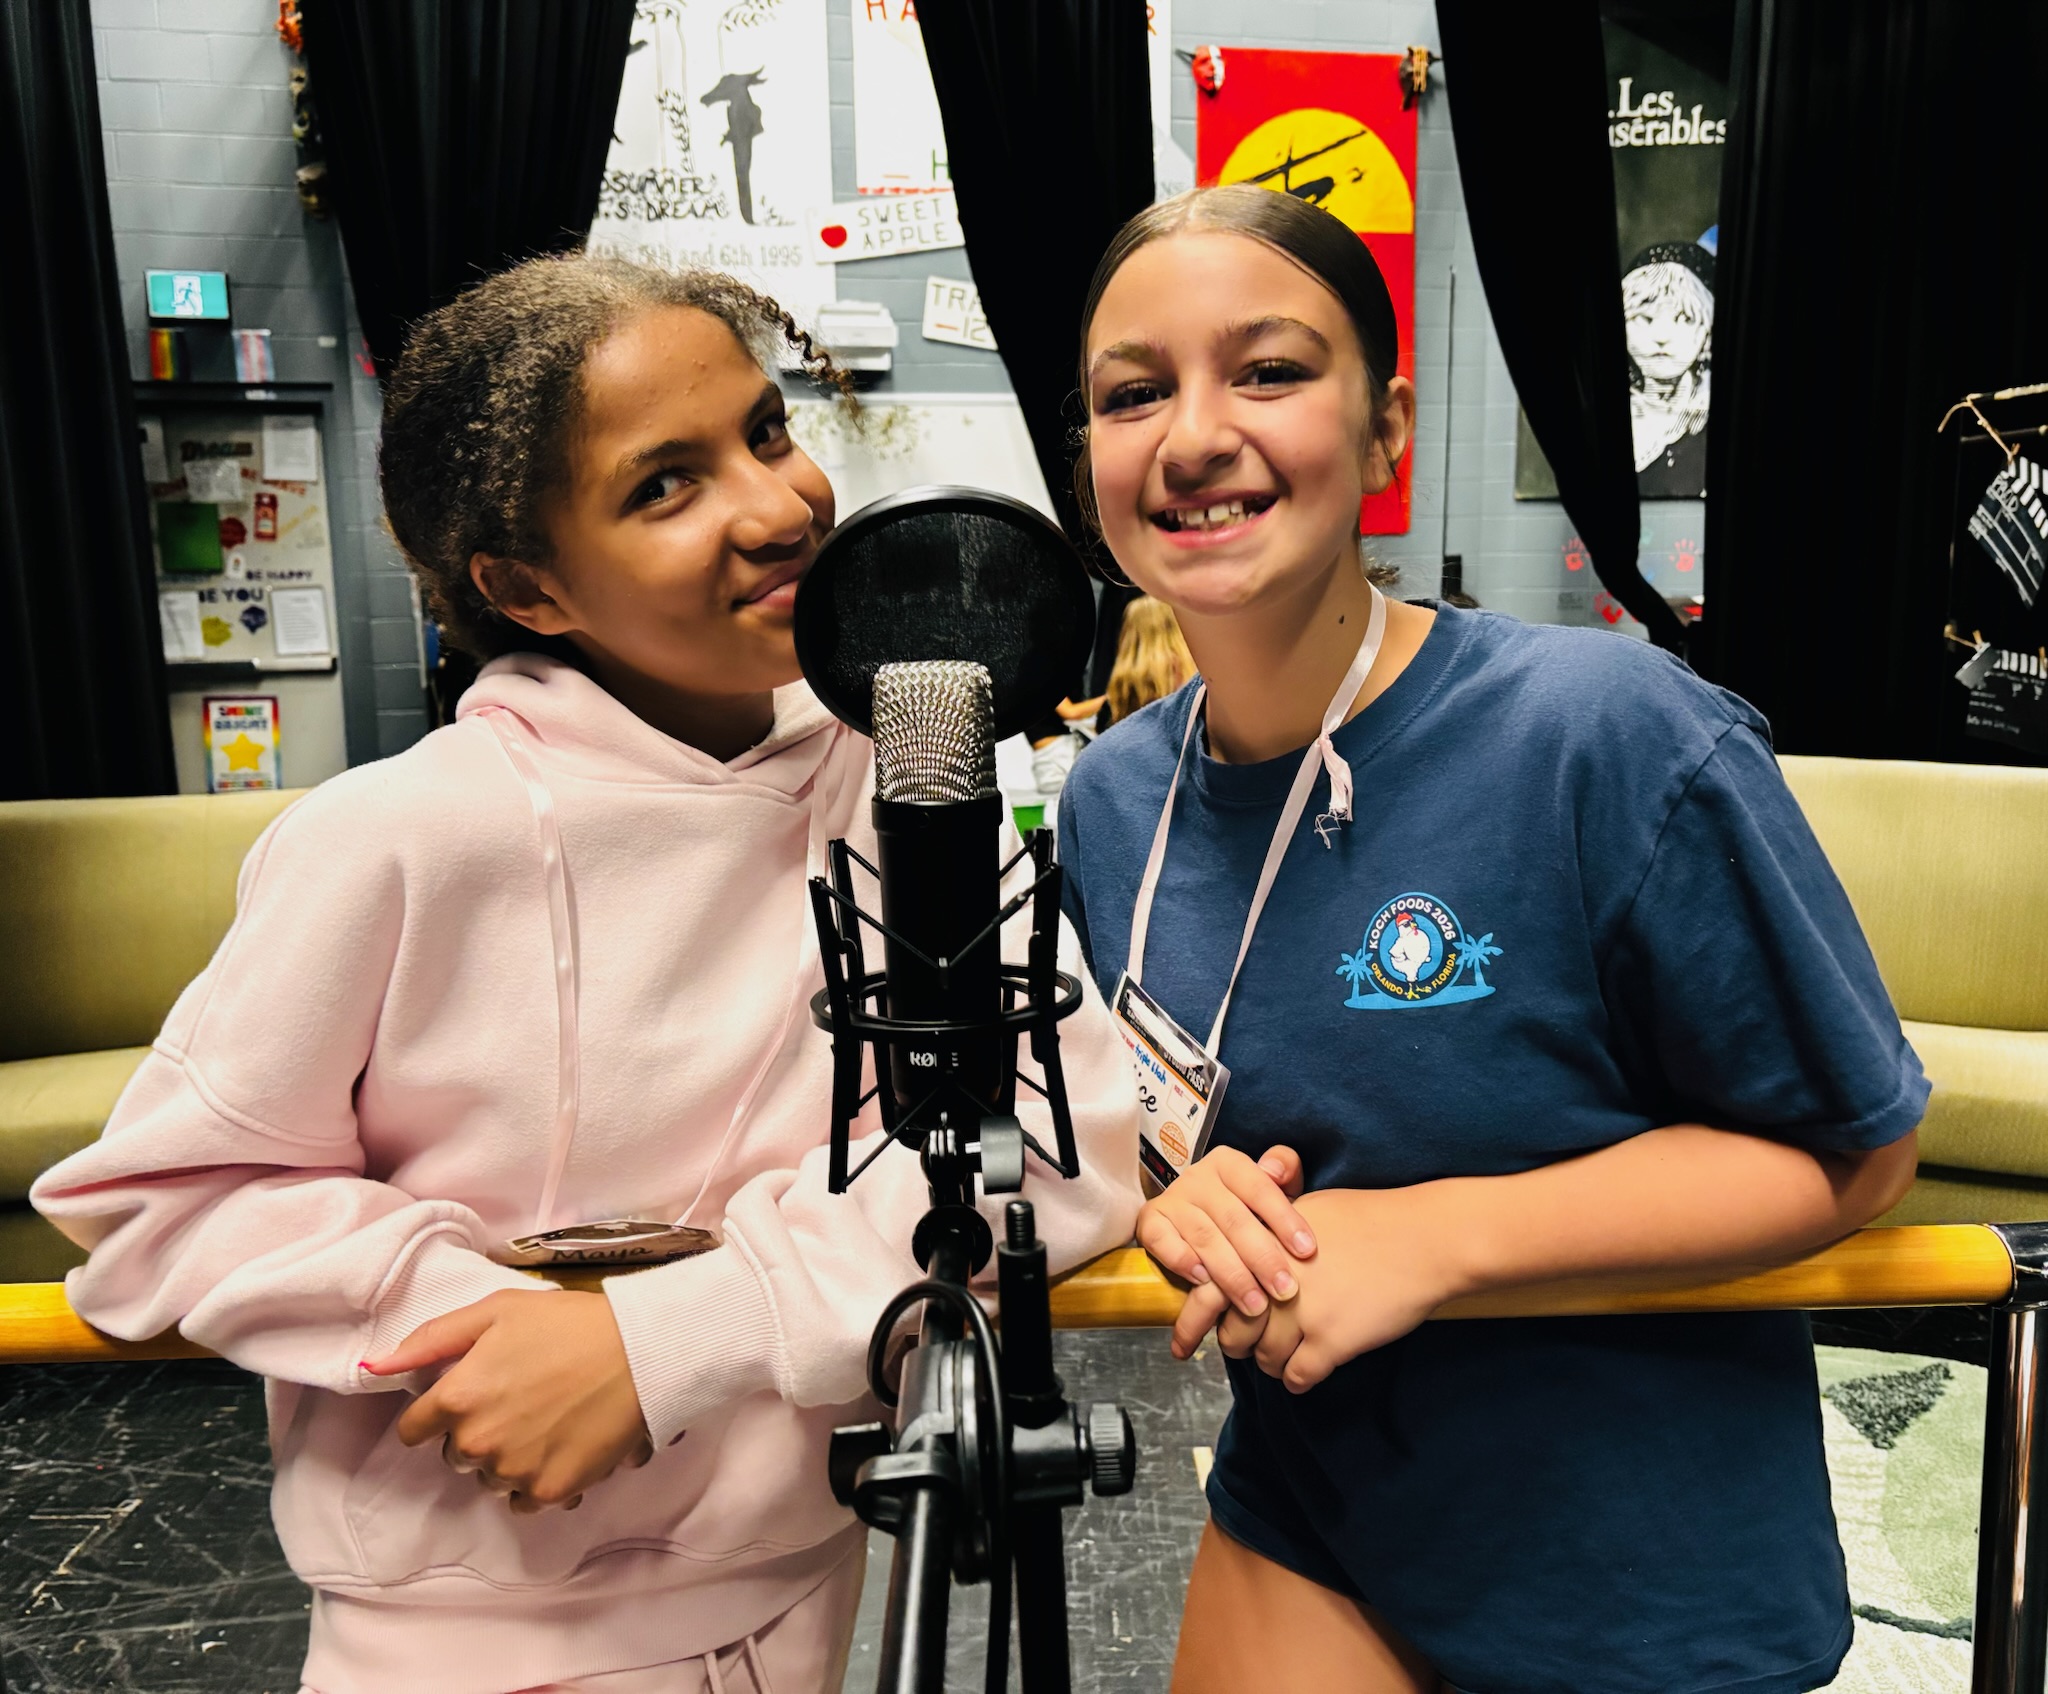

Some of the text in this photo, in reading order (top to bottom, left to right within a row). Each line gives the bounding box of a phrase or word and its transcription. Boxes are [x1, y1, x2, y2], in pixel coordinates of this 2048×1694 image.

[1616, 76, 1675, 118] Les
[646, 199, 727, 221] DREAM
[857, 197, 942, 228] SWEET
[863, 222, 949, 251] APPLE
[760, 244, 804, 267] 1995
[1369, 898, 1456, 950] KOCH FOODS 2026
[1371, 953, 1456, 995] ORLANDO FLORIDA
[1187, 1067, 1206, 1093] PASS
[551, 1246, 654, 1263] Maya
